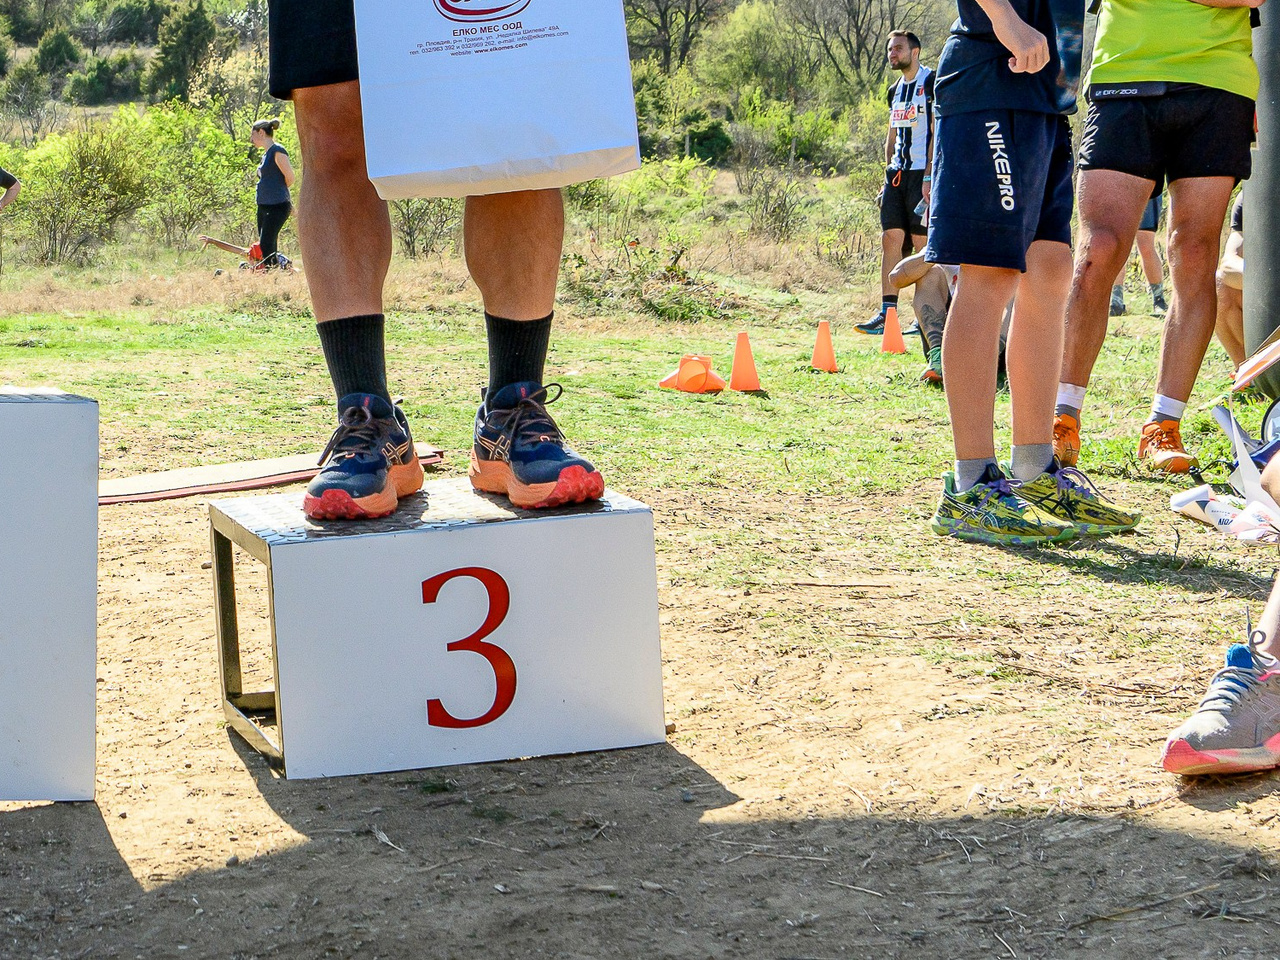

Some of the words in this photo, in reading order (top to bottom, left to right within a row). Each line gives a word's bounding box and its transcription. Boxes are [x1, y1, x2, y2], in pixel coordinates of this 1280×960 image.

[452, 27, 478, 37] ЕЛКО
[479, 24, 500, 34] МЕС
[501, 21, 523, 30] ООД
[420, 566, 515, 729] 3
